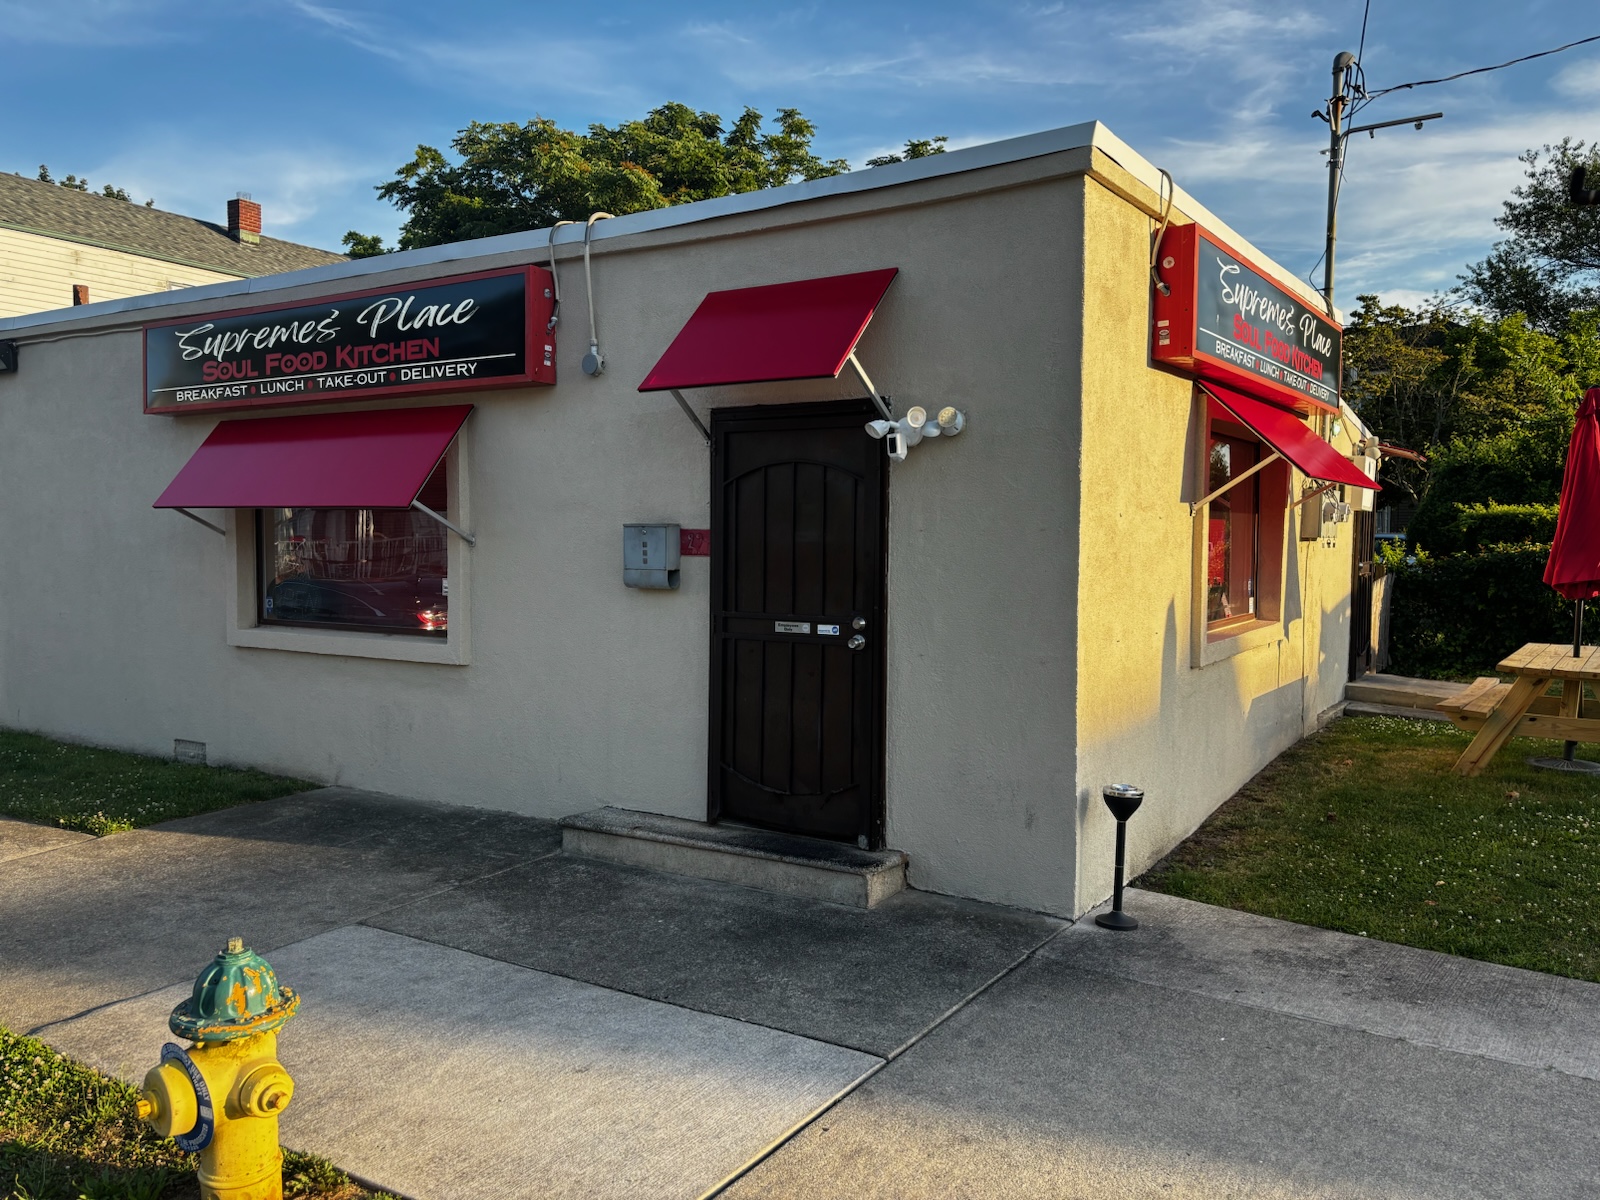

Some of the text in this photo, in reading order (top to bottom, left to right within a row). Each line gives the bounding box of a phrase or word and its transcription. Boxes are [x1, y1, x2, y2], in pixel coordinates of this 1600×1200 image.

[356, 295, 480, 338] Place
[1299, 313, 1333, 358] Place
[202, 336, 440, 382] SOUL FOOD KITCHEN
[1232, 313, 1323, 380] SOUL FOOD KITCHEN
[176, 362, 478, 402] BREAKFAST LUNCH TAKE-OUT DELIVERY
[1215, 340, 1256, 369] BREAKFAST
[1259, 361, 1280, 379] LUNCH
[1309, 383, 1330, 401] DELIVERY
[190, 1064, 202, 1080] USE
[199, 1080, 211, 1101] ONLY
